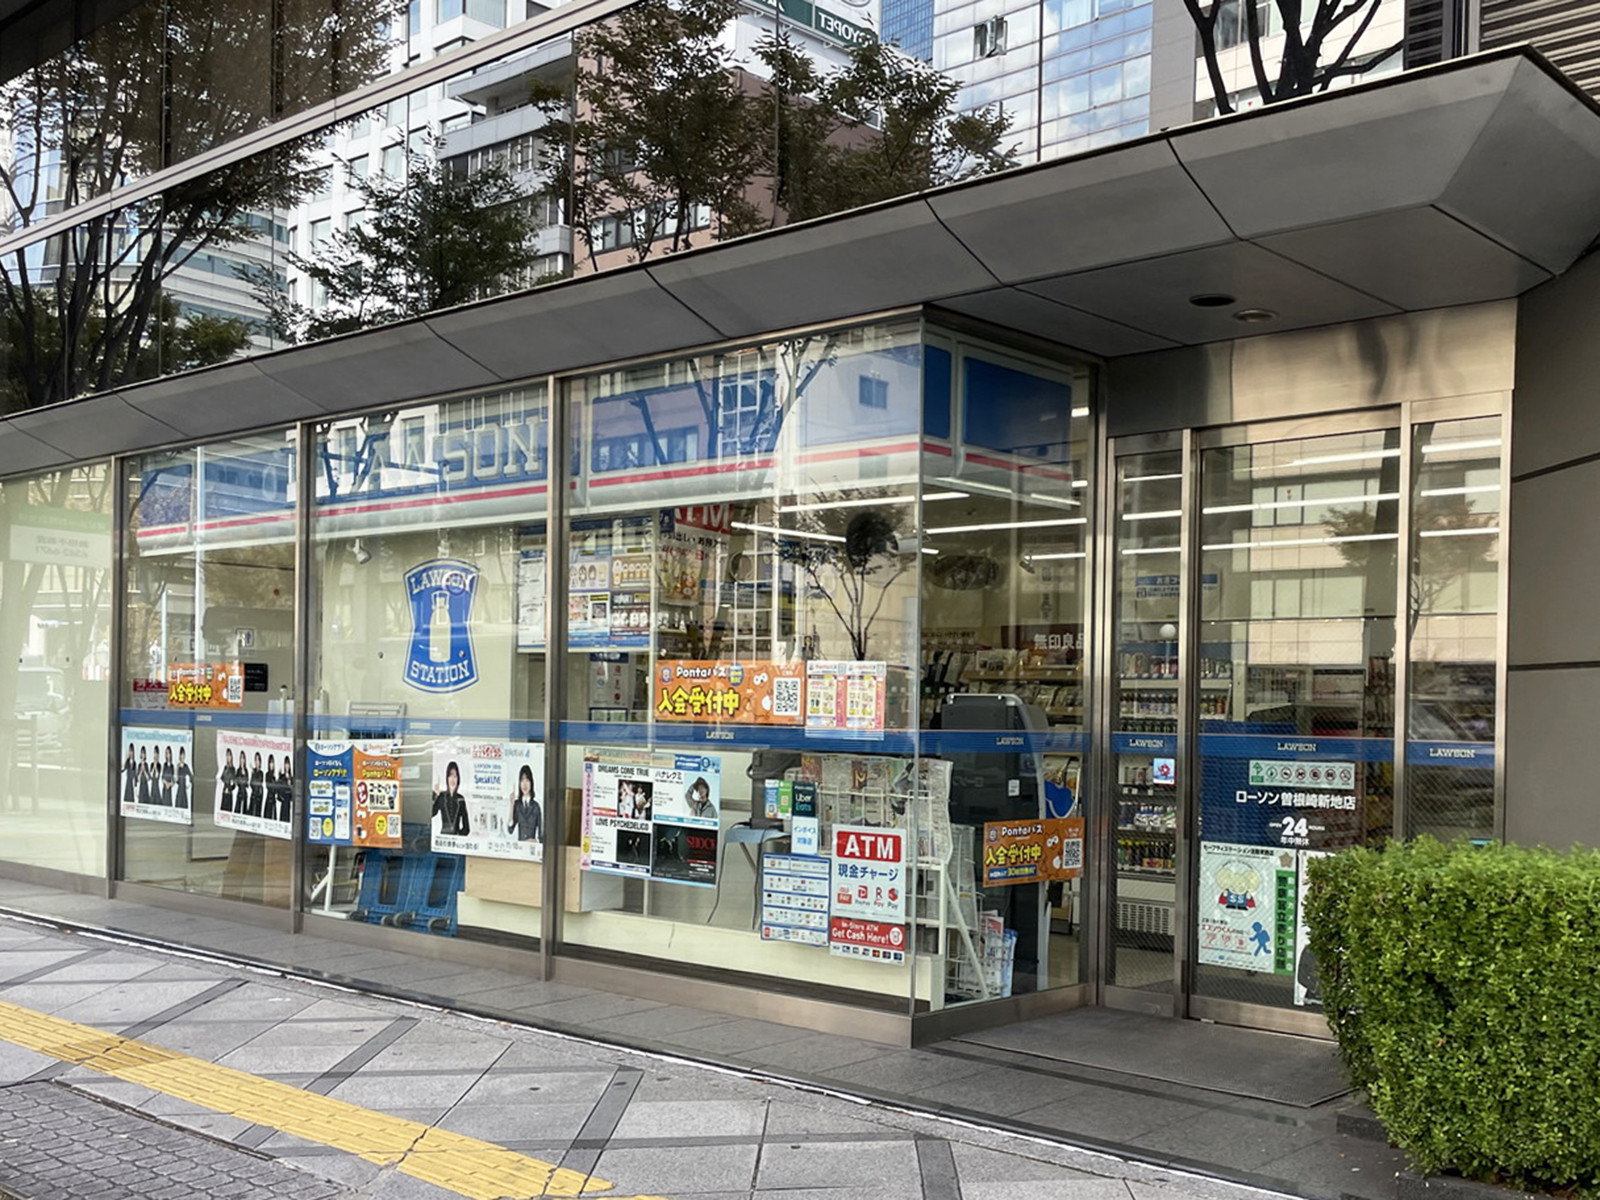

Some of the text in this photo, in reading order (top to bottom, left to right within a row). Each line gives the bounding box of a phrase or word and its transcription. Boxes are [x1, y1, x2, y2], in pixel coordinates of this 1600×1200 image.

[411, 569, 472, 595] LAWSON
[410, 660, 470, 684] STATION
[169, 682, 212, 703] 入会受付中
[657, 686, 741, 716] 入会受付中
[1129, 738, 1164, 748] LAWSON
[1277, 742, 1317, 752] LAWSON
[1429, 747, 1475, 758] LAWSON
[598, 765, 649, 777] DREAMS COME TRUE
[655, 771, 683, 781] ハナレグミ
[795, 793, 812, 803] Uber
[795, 802, 812, 811] Eats
[595, 818, 609, 827] LOVE
[1282, 816, 1308, 837] 24
[844, 834, 894, 860] ATM
[1280, 837, 1310, 846] 年中無休
[985, 843, 1042, 866] 入会受付中
[838, 863, 899, 881] 現金チャージ
[866, 923, 879, 932] ATM
[832, 928, 889, 944] Get Cash Here!
